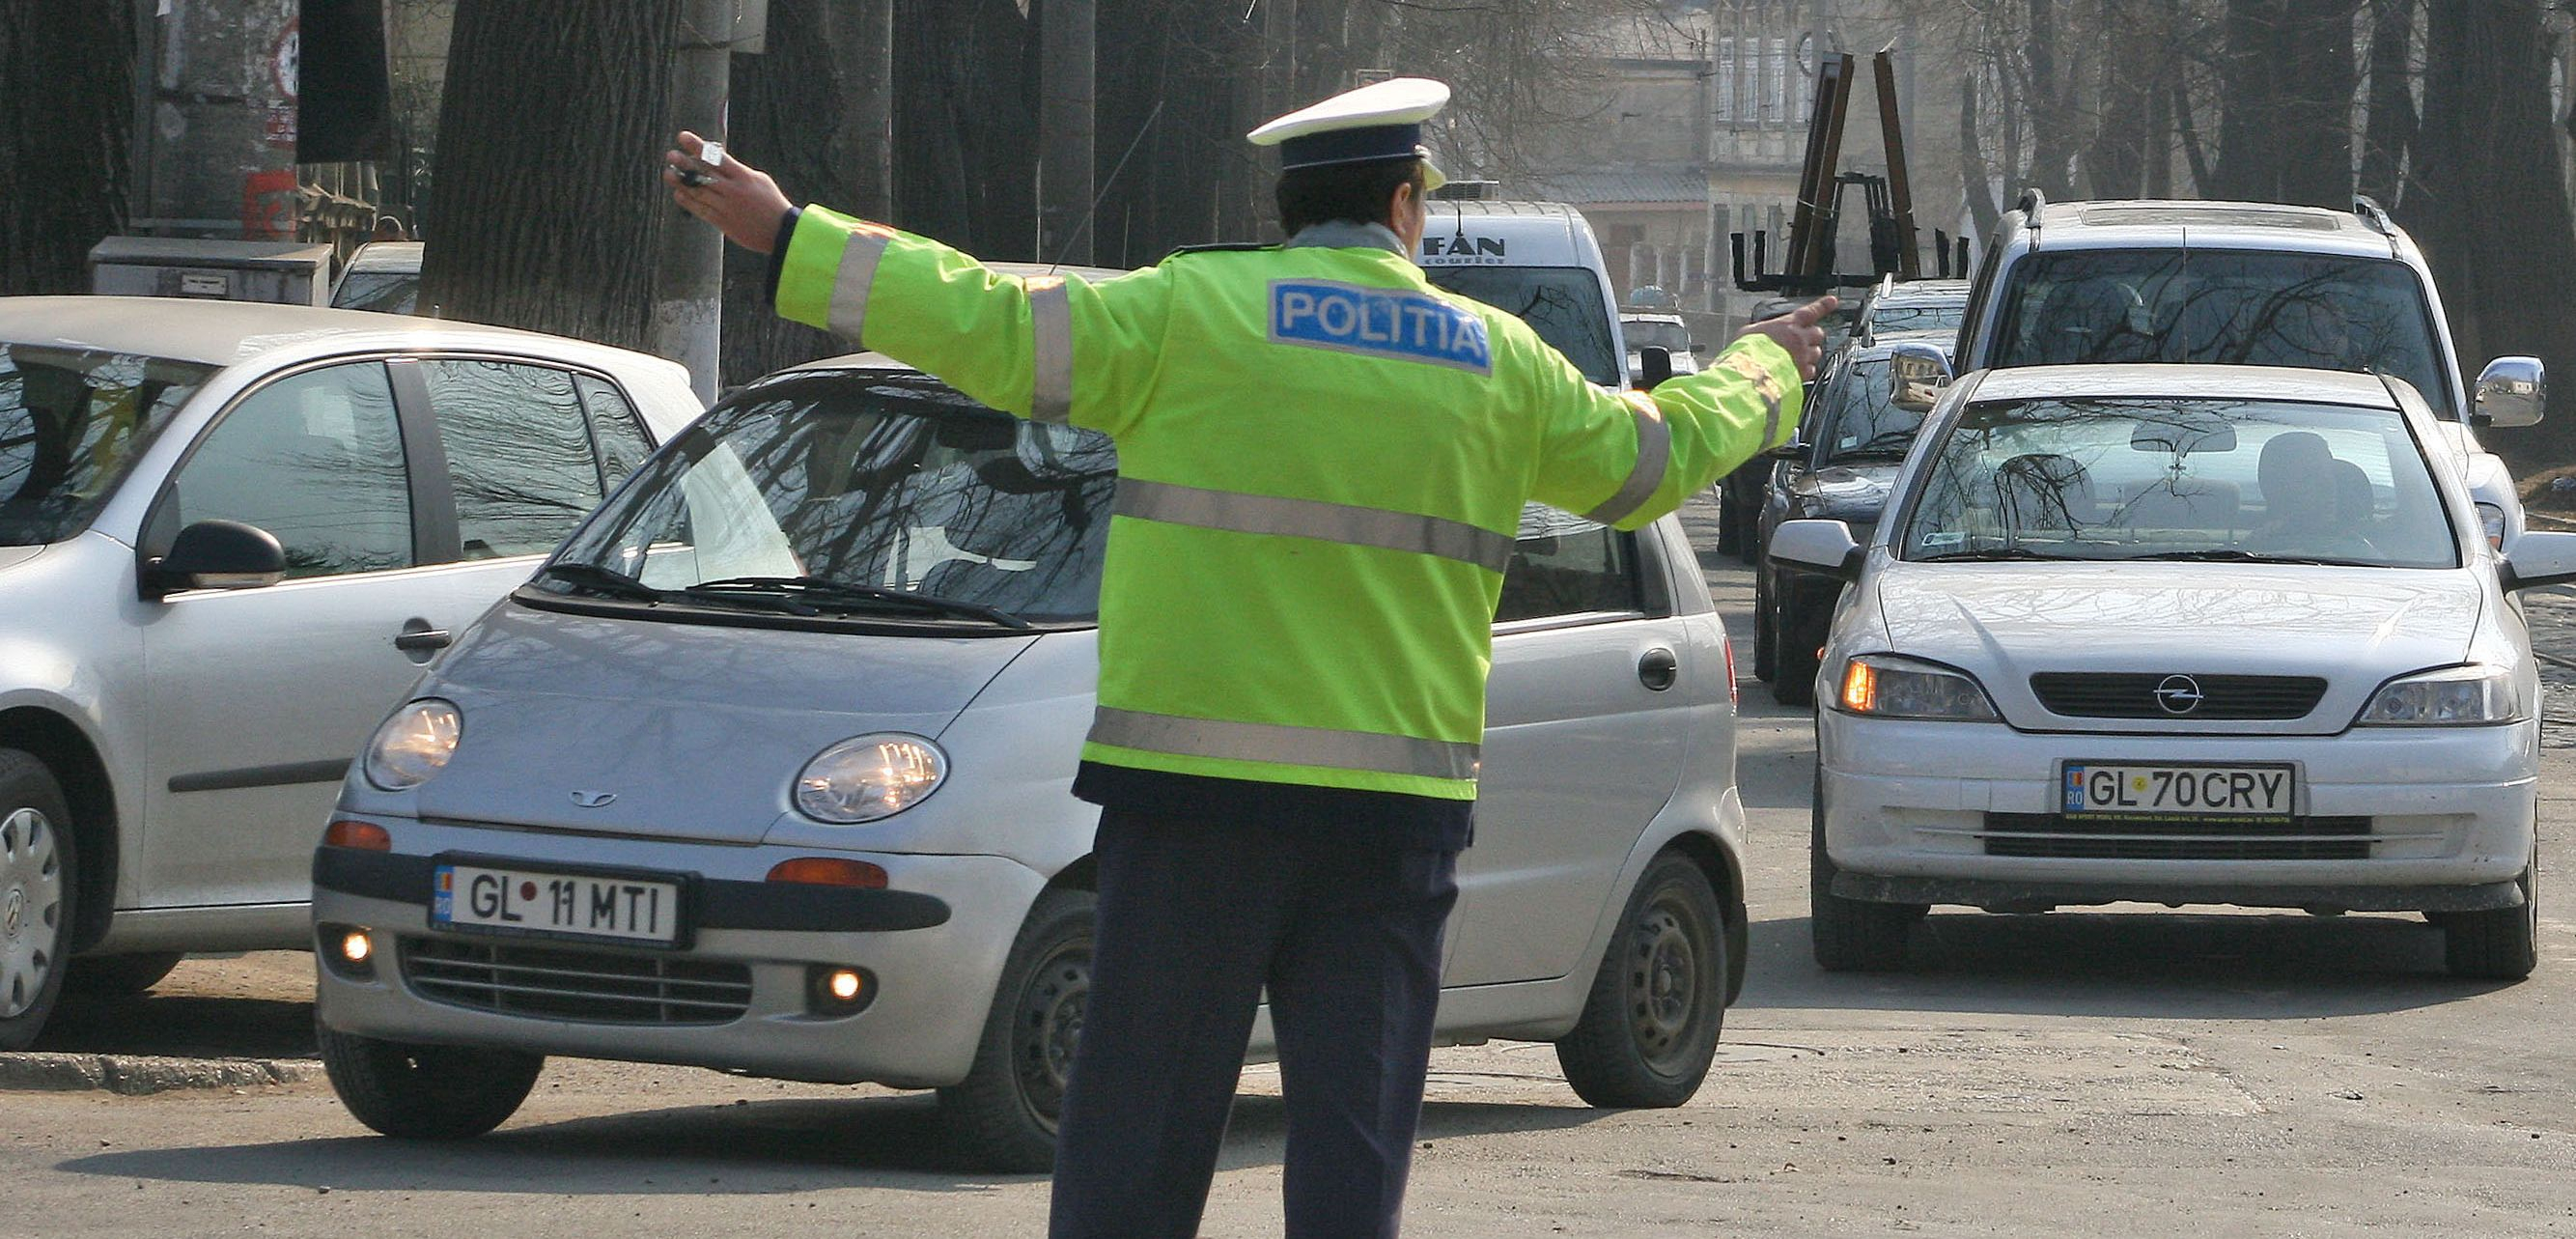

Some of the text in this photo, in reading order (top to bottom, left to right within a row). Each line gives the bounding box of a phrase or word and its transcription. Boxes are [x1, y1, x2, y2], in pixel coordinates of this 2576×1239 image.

[1422, 237, 1505, 257] FAN
[1424, 256, 1505, 265] courier
[1280, 291, 1483, 358] POLITIA
[2066, 789, 2083, 805] RO
[2088, 771, 2138, 807] GL
[470, 873, 658, 934] GL 11 MTI
